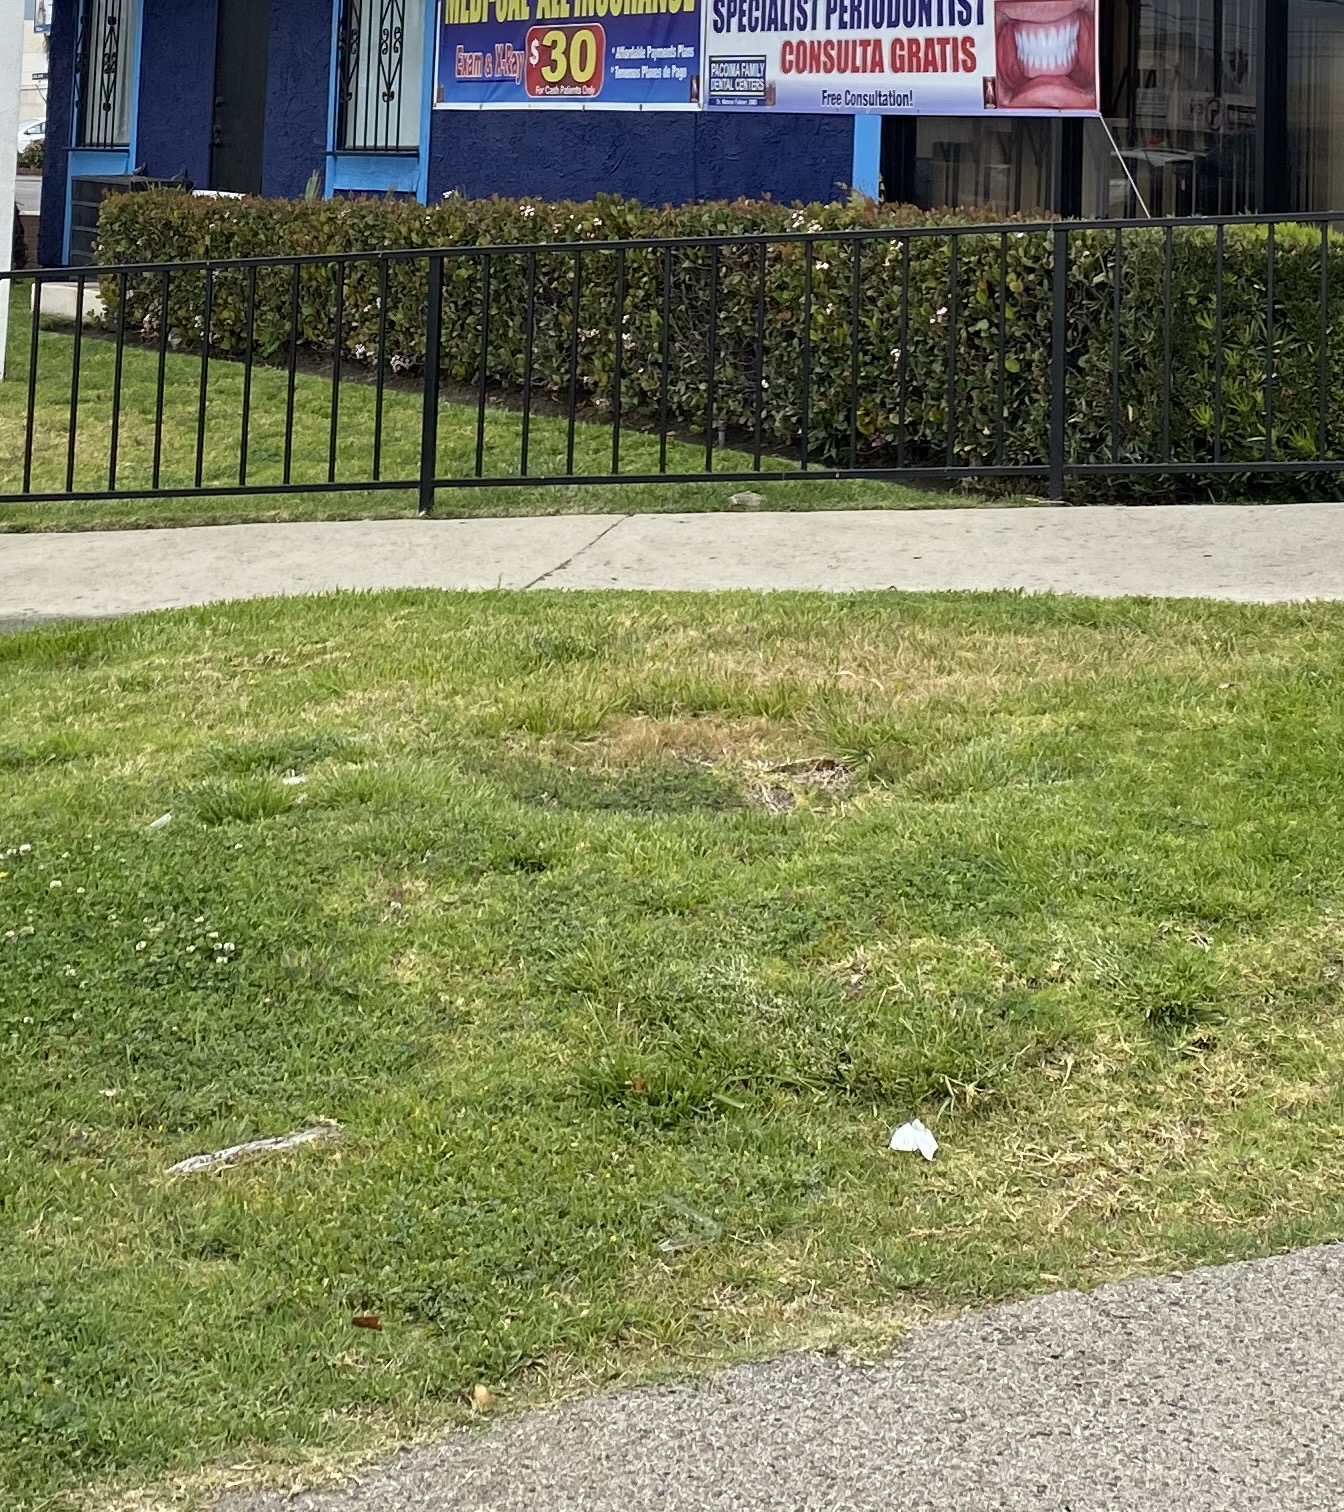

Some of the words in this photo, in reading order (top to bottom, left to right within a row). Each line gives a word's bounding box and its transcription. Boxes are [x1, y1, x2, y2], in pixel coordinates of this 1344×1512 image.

[455, 44, 483, 78] Exam
[494, 42, 526, 85] X-Ray
[780, 38, 884, 74] CONSULTA
[890, 35, 977, 74] GRATIS
[710, 62, 740, 77] PACOIMA
[741, 62, 765, 77] FAMILY
[710, 78, 734, 90] DENTAL
[735, 78, 765, 90] CENTERS
[821, 89, 842, 107] Free
[844, 88, 914, 108] Consultation!
